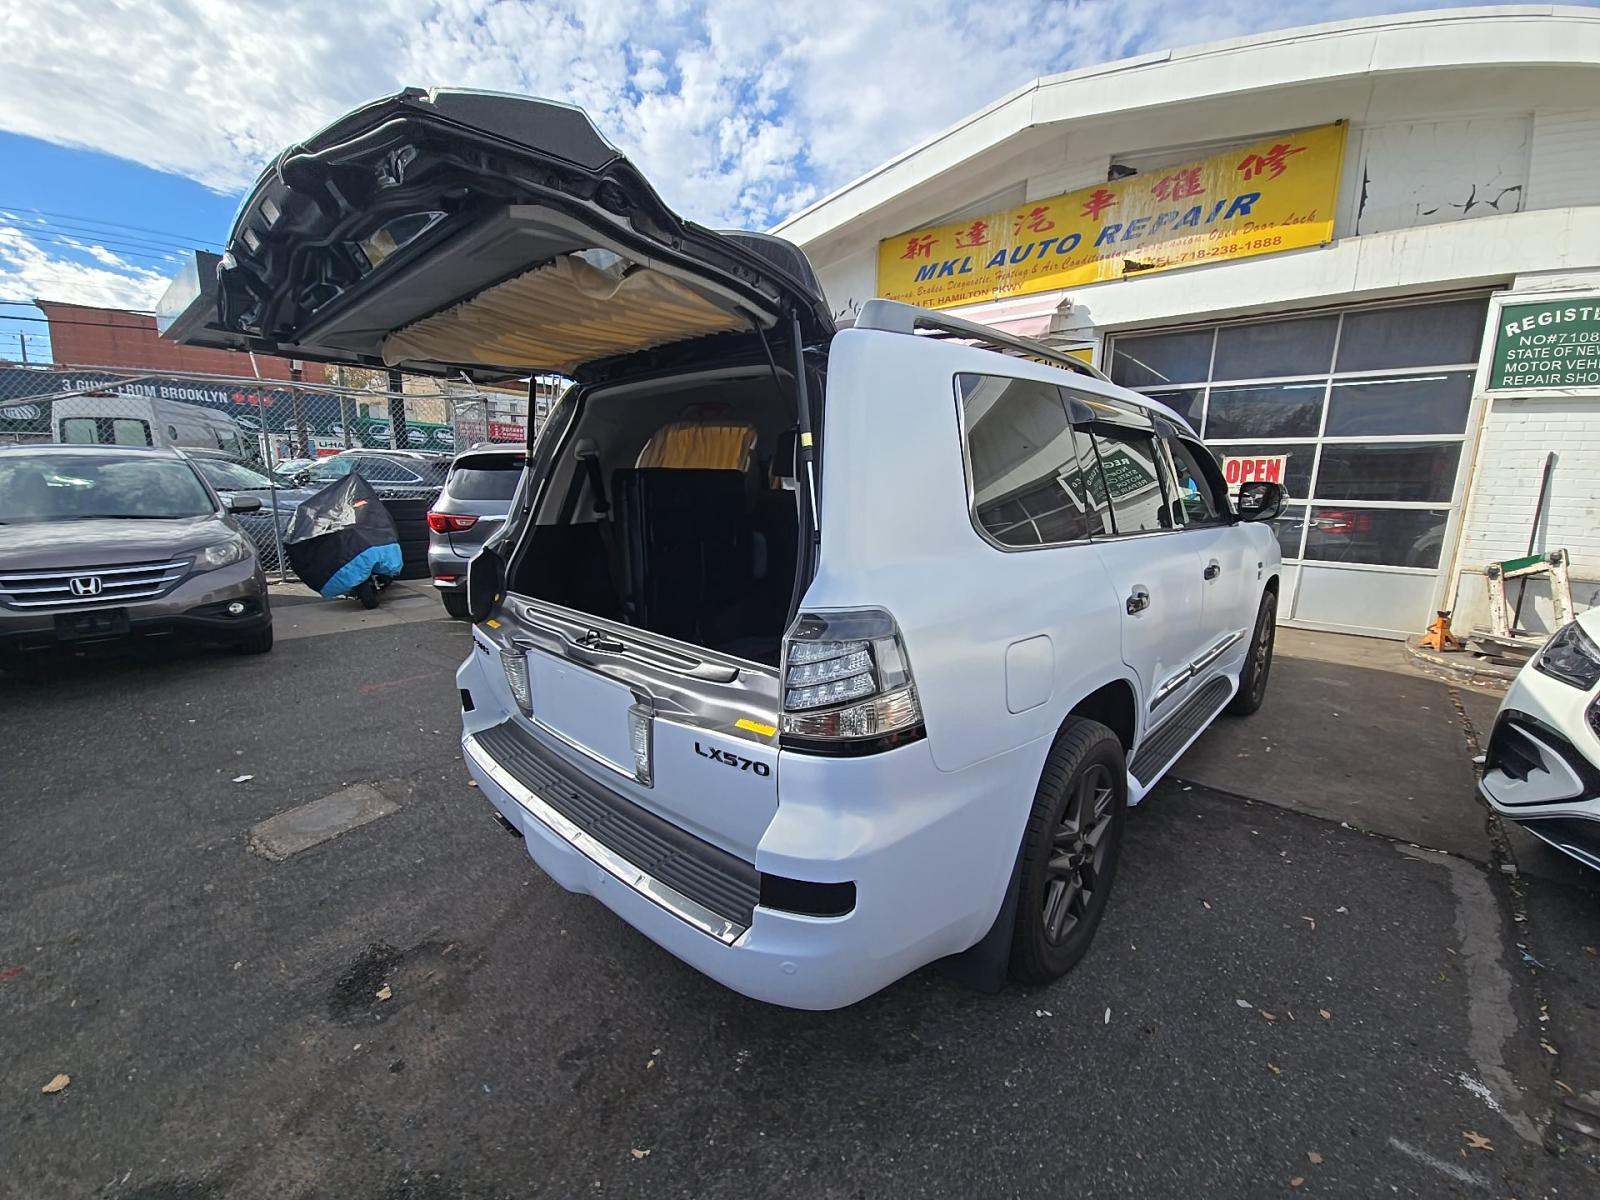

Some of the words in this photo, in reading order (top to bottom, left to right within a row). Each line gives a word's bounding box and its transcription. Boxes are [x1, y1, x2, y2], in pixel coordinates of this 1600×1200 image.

[1242, 221, 1274, 235] Door
[1281, 208, 1318, 226] Lock
[913, 256, 973, 283] MKL
[986, 233, 1082, 269] AUTO
[1094, 192, 1261, 248] REPAIR
[937, 288, 990, 305] HAMILTON
[991, 282, 1024, 295] PKWY
[1506, 347, 1551, 360] STATE
[1553, 346, 1574, 357] OF
[1576, 344, 1600, 356] NE
[1504, 360, 1562, 373] MOTOR
[62, 379, 73, 392] 3
[161, 386, 229, 403] BROOKLYN
[1502, 373, 1561, 386] REPAIR
[1565, 372, 1599, 383] SHO
[1225, 458, 1281, 484] OPEN
[694, 741, 770, 777] LX570
